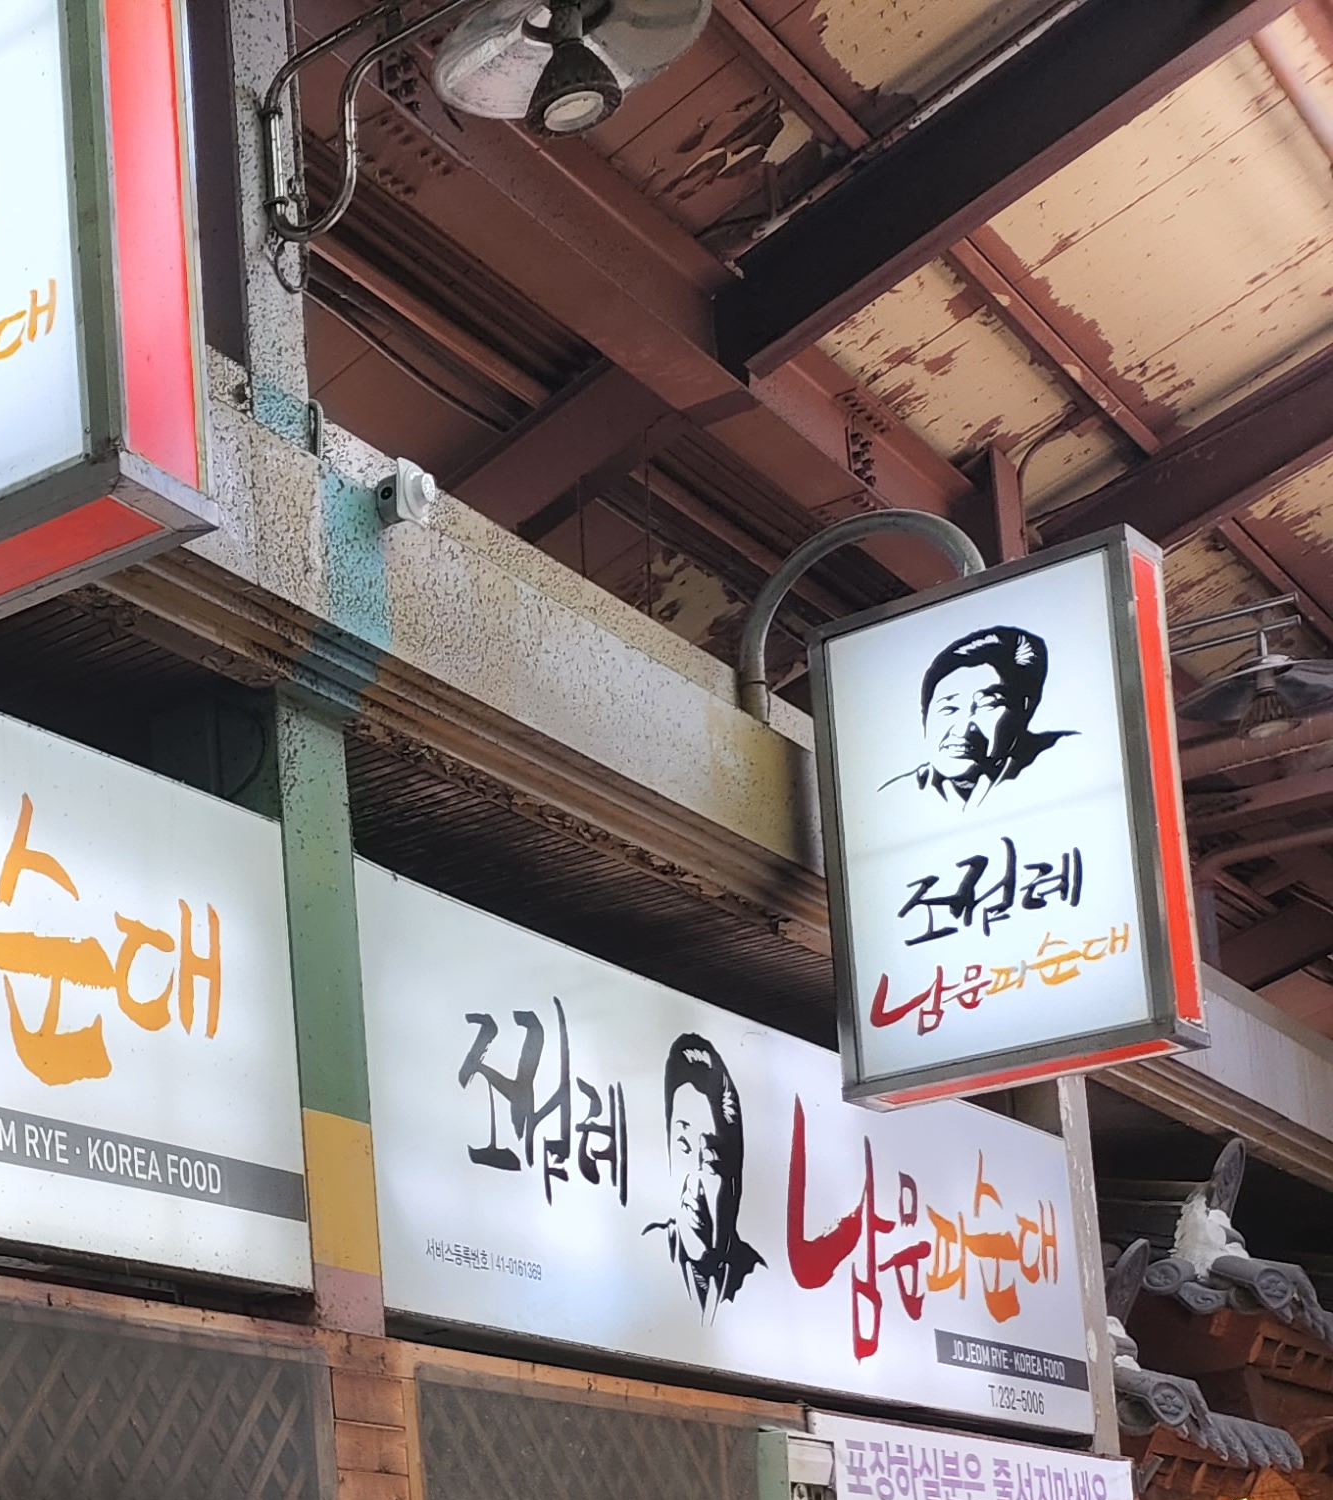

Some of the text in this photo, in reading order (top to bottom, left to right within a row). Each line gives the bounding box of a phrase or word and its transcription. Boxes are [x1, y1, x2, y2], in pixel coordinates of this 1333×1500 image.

[897, 836, 1083, 946] 조점례
[458, 996, 629, 1207] 조점례
[24, 1123, 69, 1165] RYE
[87, 1137, 163, 1184] KOREA
[166, 1155, 221, 1195] FOOD
[426, 1238, 541, 1280] 서비스등록번호 41-0161369
[952, 1340, 1065, 1380] JO JEOM RYE KOREA FOOD
[988, 1384, 1045, 1415] T.232-5006
